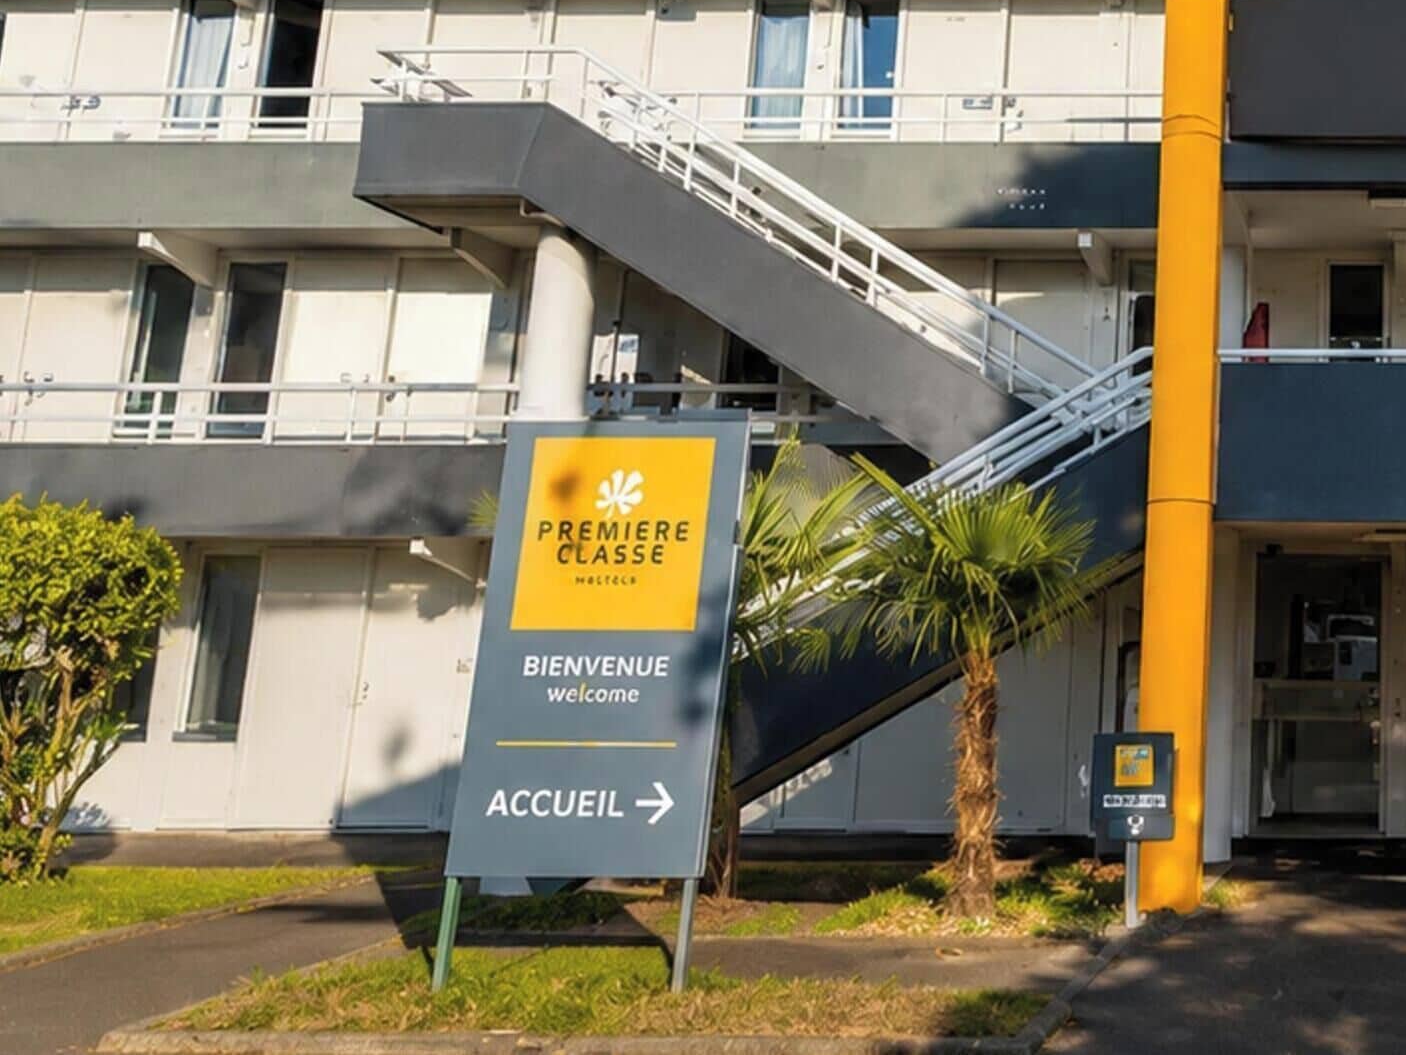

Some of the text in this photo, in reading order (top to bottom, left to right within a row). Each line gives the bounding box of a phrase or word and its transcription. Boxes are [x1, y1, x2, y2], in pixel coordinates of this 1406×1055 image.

[537, 520, 690, 542] PREMIERE
[557, 543, 665, 565] CLASSE
[522, 655, 670, 677] BIENVENUE
[547, 682, 640, 703] welcome
[486, 789, 624, 817] ACCUEIL
